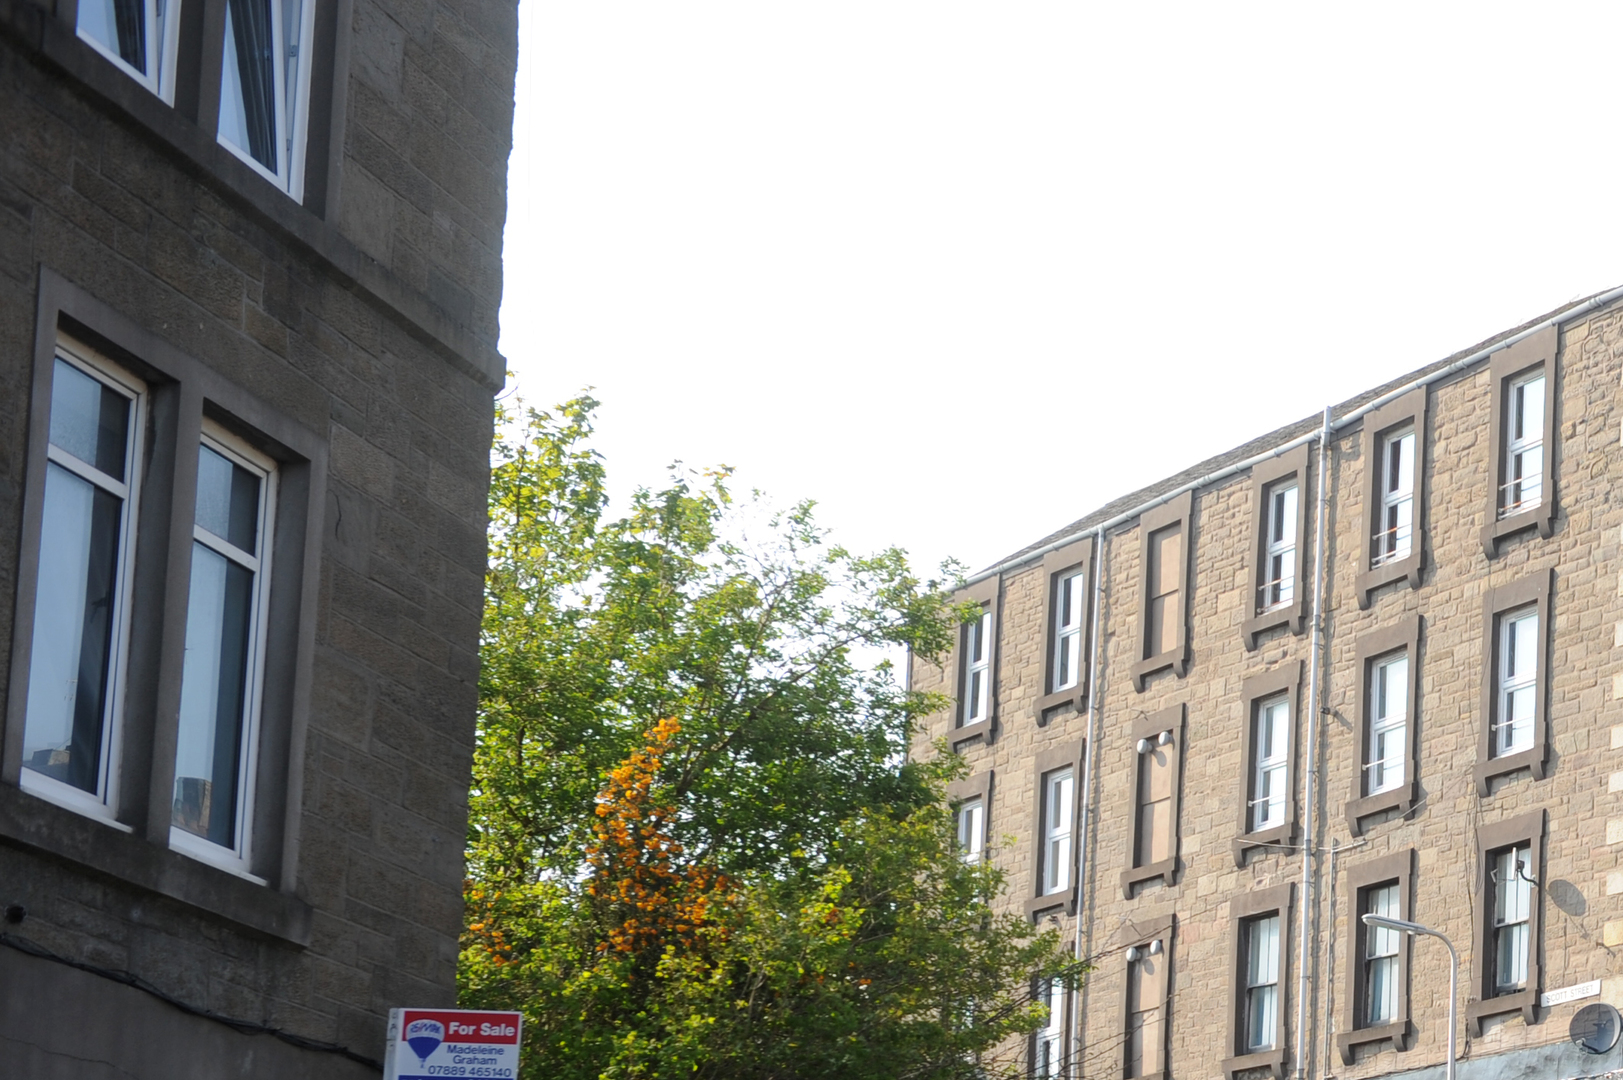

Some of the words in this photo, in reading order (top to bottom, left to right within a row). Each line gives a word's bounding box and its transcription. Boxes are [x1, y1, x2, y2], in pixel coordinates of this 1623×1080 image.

[1546, 991, 1568, 1003] SCOTT
[1570, 984, 1594, 998] STREET
[448, 1021, 477, 1035] For
[480, 1022, 515, 1036] Sale
[446, 1044, 505, 1056] Madeleine
[452, 1055, 497, 1065] Graham
[428, 1065, 466, 1076] 07889
[468, 1067, 512, 1078] 465140
